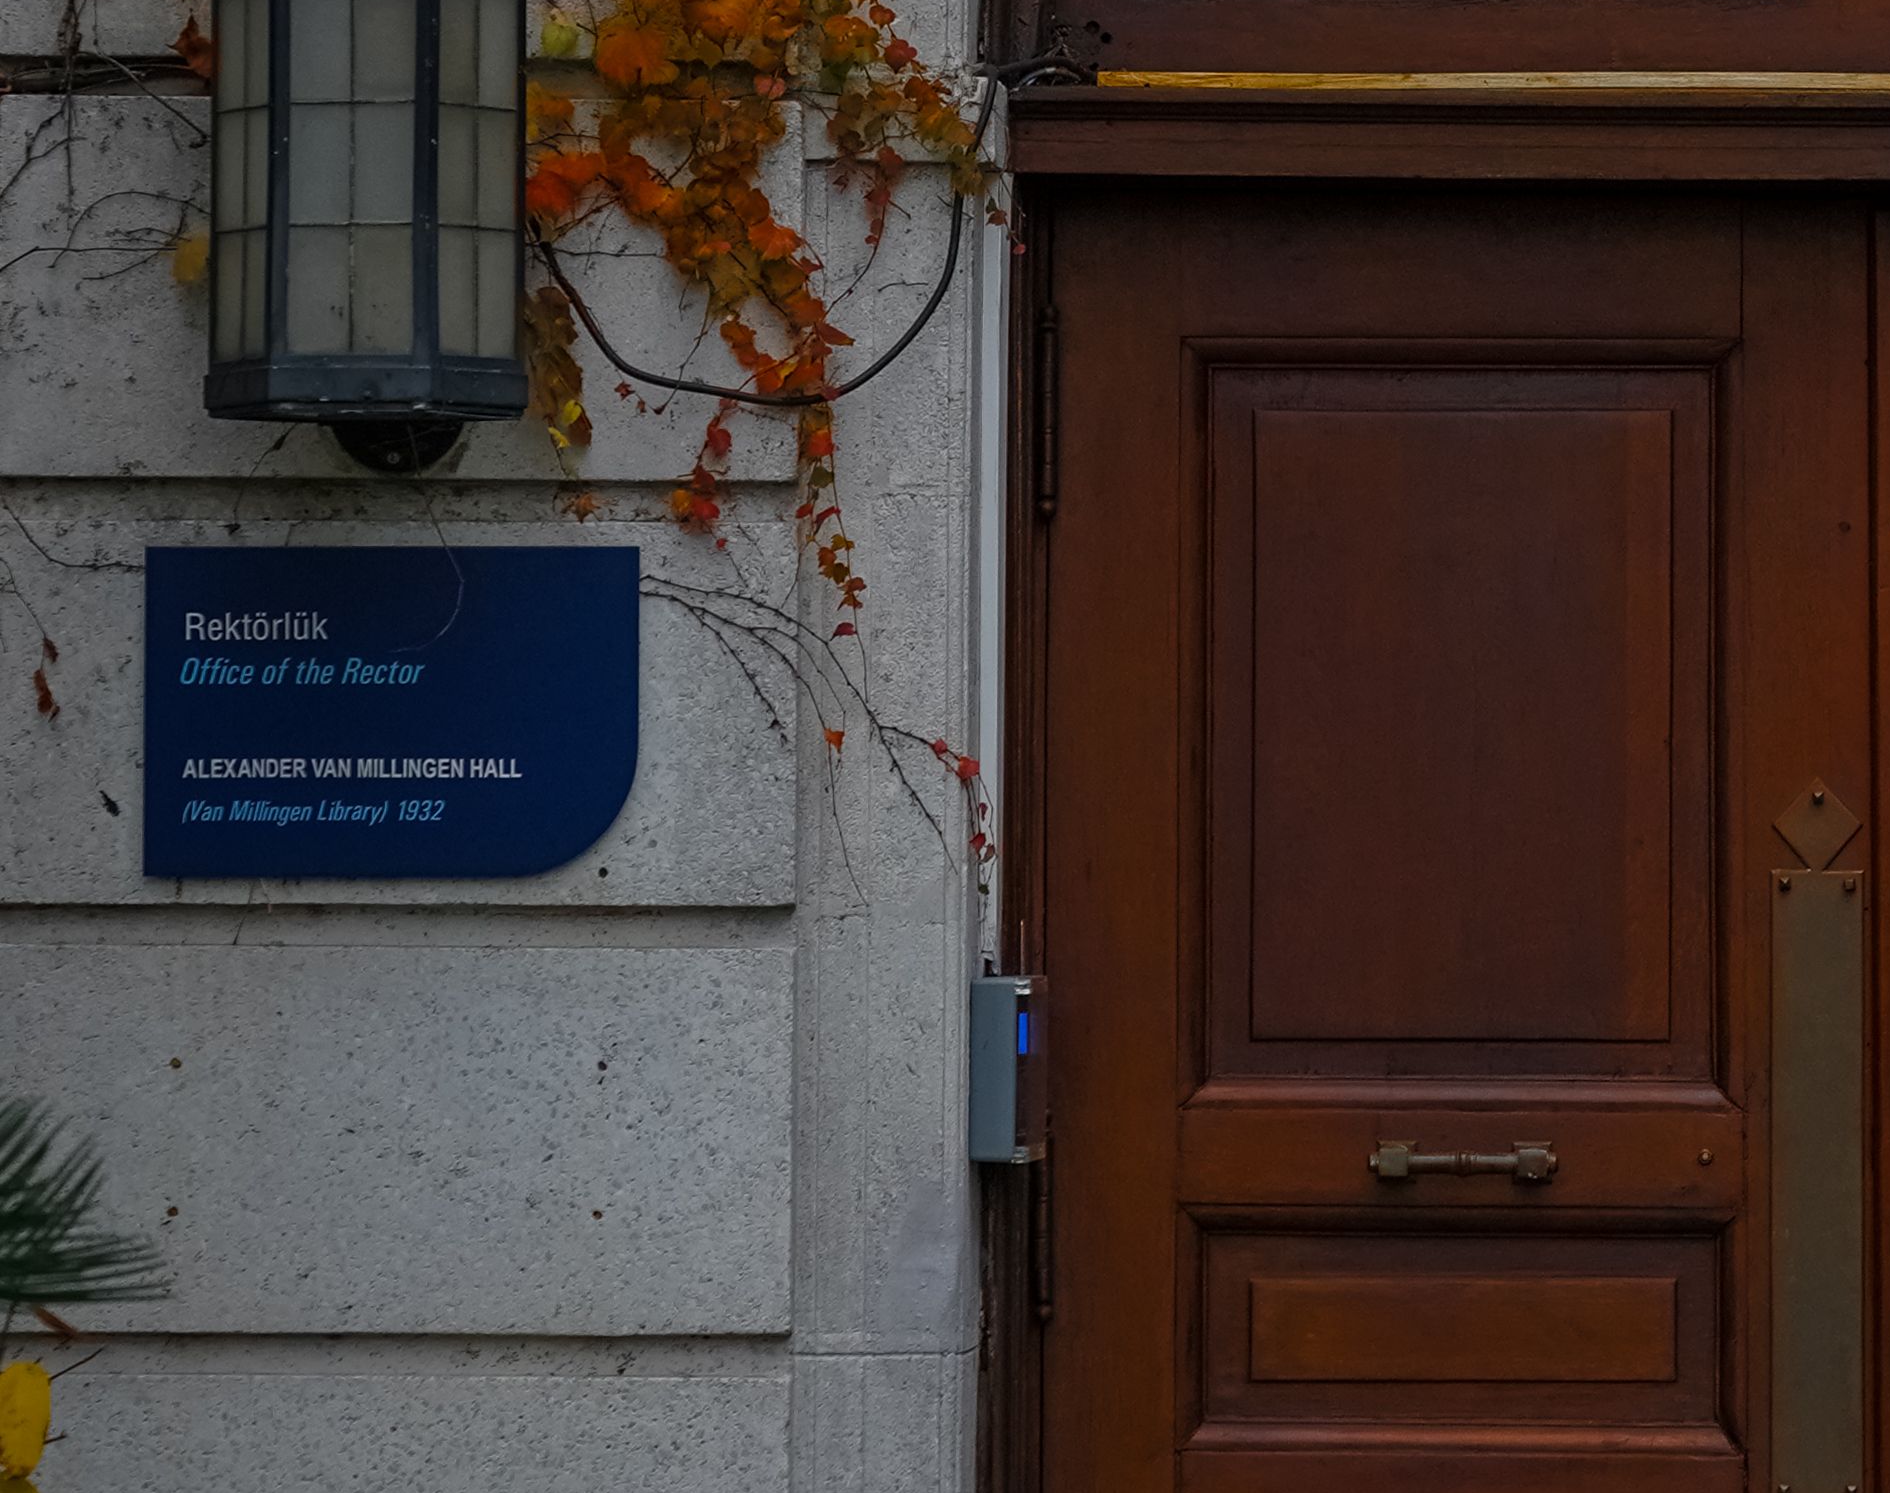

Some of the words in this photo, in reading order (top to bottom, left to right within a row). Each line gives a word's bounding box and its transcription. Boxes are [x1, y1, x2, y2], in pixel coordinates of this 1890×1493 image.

[184, 611, 329, 642] Rektörlük
[179, 657, 254, 685] Office
[261, 657, 291, 685] of
[295, 658, 334, 685] the
[341, 657, 426, 685] Rector
[181, 758, 308, 779] ALEXANDER
[311, 758, 353, 779] VAN
[356, 758, 465, 779] MILLINGEN
[469, 758, 523, 779] HALL
[181, 800, 225, 824] (Van
[228, 800, 313, 827] Millingen
[316, 799, 389, 827] Library)
[397, 799, 447, 822] 1932
